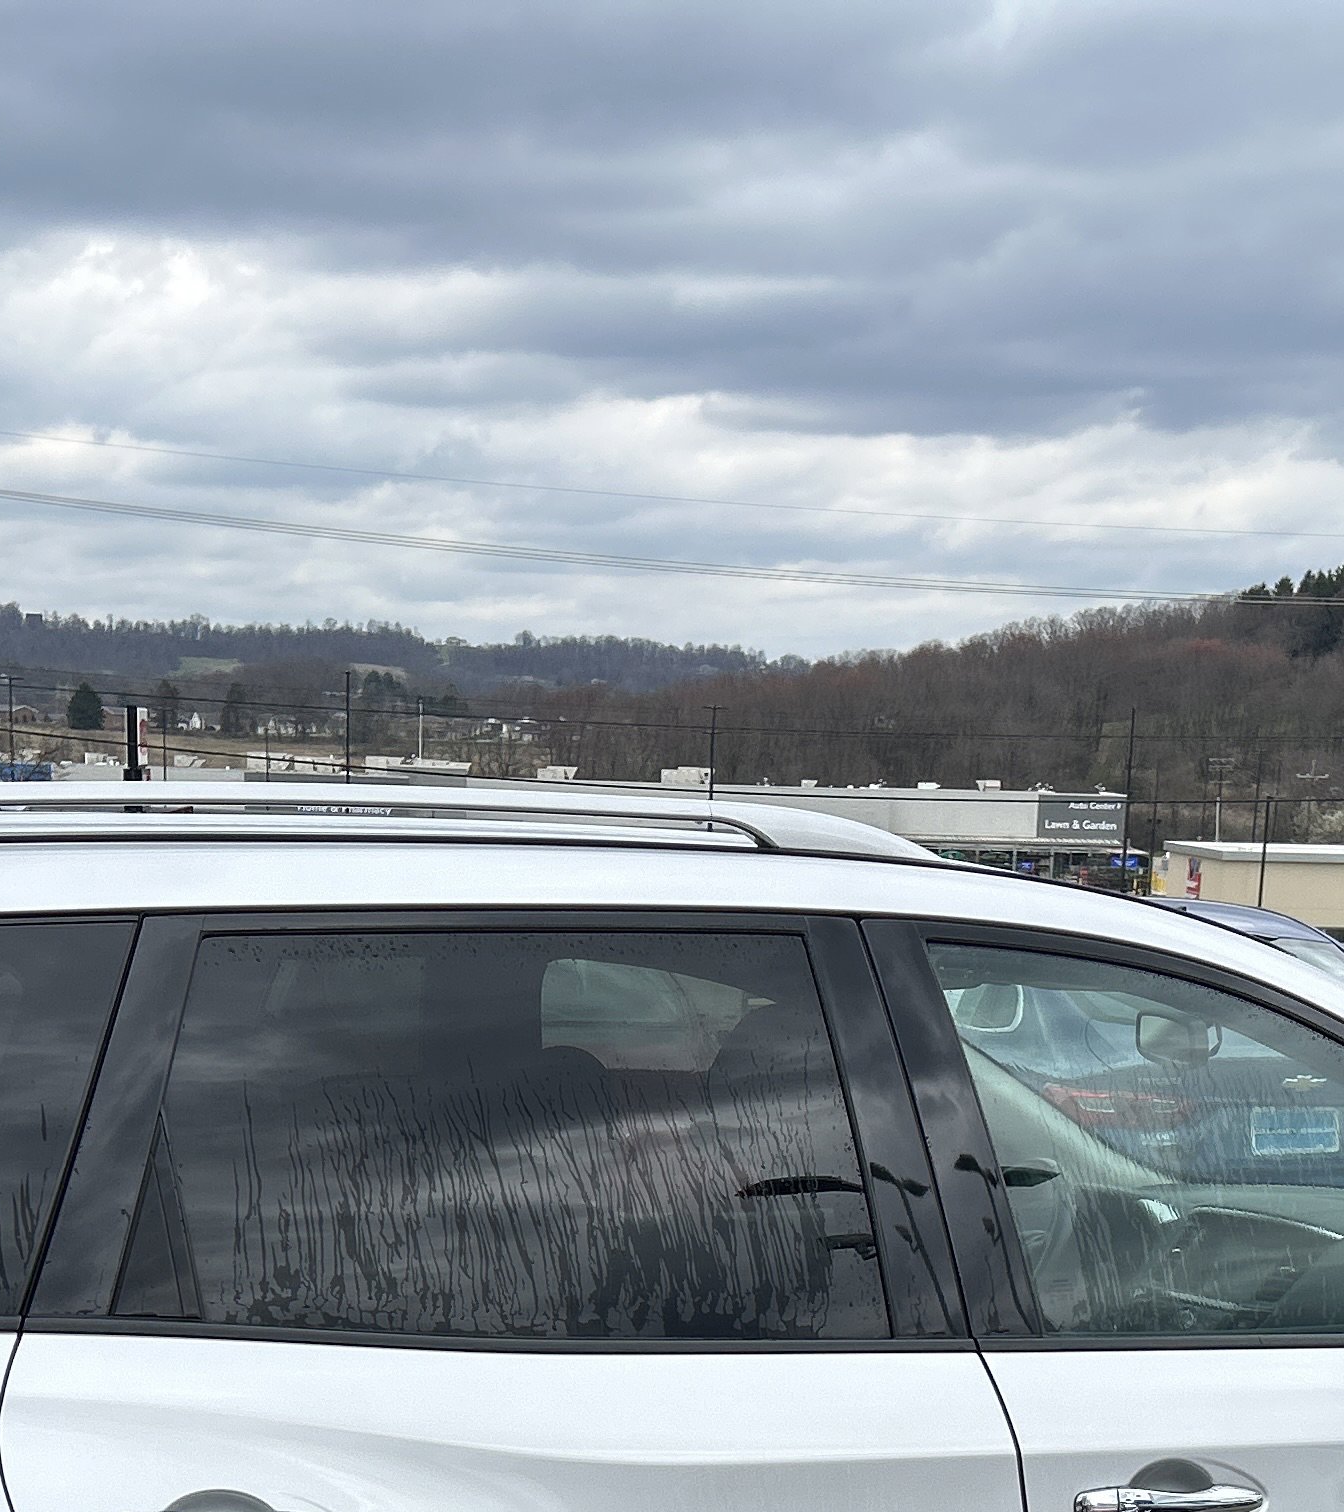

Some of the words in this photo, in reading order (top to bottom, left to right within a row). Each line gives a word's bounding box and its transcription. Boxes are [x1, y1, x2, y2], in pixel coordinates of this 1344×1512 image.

[1044, 819, 1070, 829] Lawn
[1072, 819, 1080, 830] &
[1082, 819, 1117, 831] Garden
